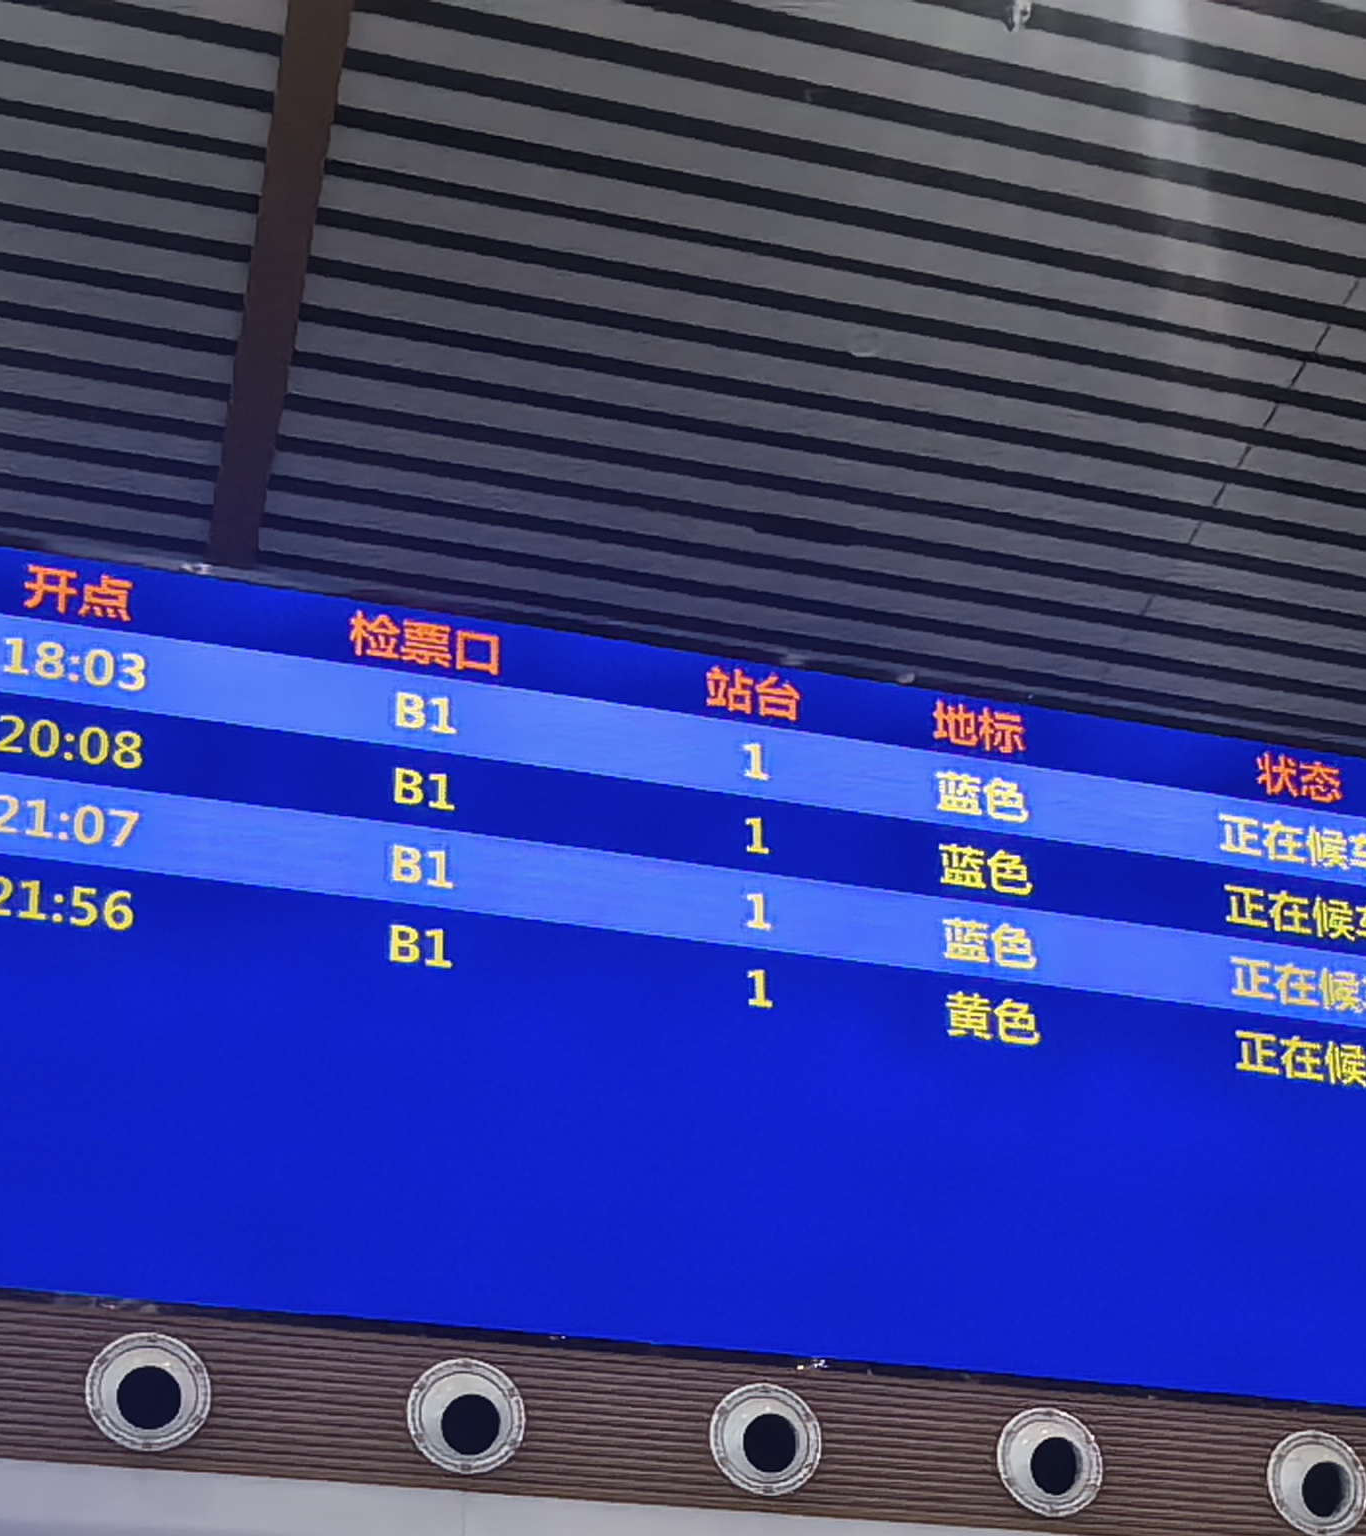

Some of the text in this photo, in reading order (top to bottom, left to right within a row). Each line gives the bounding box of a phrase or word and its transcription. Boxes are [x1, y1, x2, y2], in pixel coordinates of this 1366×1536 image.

[3, 638, 145, 691] 18:03
[395, 692, 457, 734] B1
[743, 743, 770, 780] 1
[935, 770, 1029, 823] 蓝色
[24, 565, 132, 621] 开点
[350, 610, 499, 675] 检票口
[706, 666, 800, 721] 站台
[933, 700, 1025, 753] 地标
[1257, 753, 1342, 802] 状态
[394, 768, 454, 810] B1
[746, 818, 769, 854] 1
[939, 844, 1032, 895] 蓝色
[391, 844, 454, 889] B1
[746, 893, 772, 931] 1
[942, 918, 1037, 969] 蓝色
[390, 925, 452, 968] B1
[748, 970, 772, 1008] 1
[946, 991, 1040, 1045] 黄色
